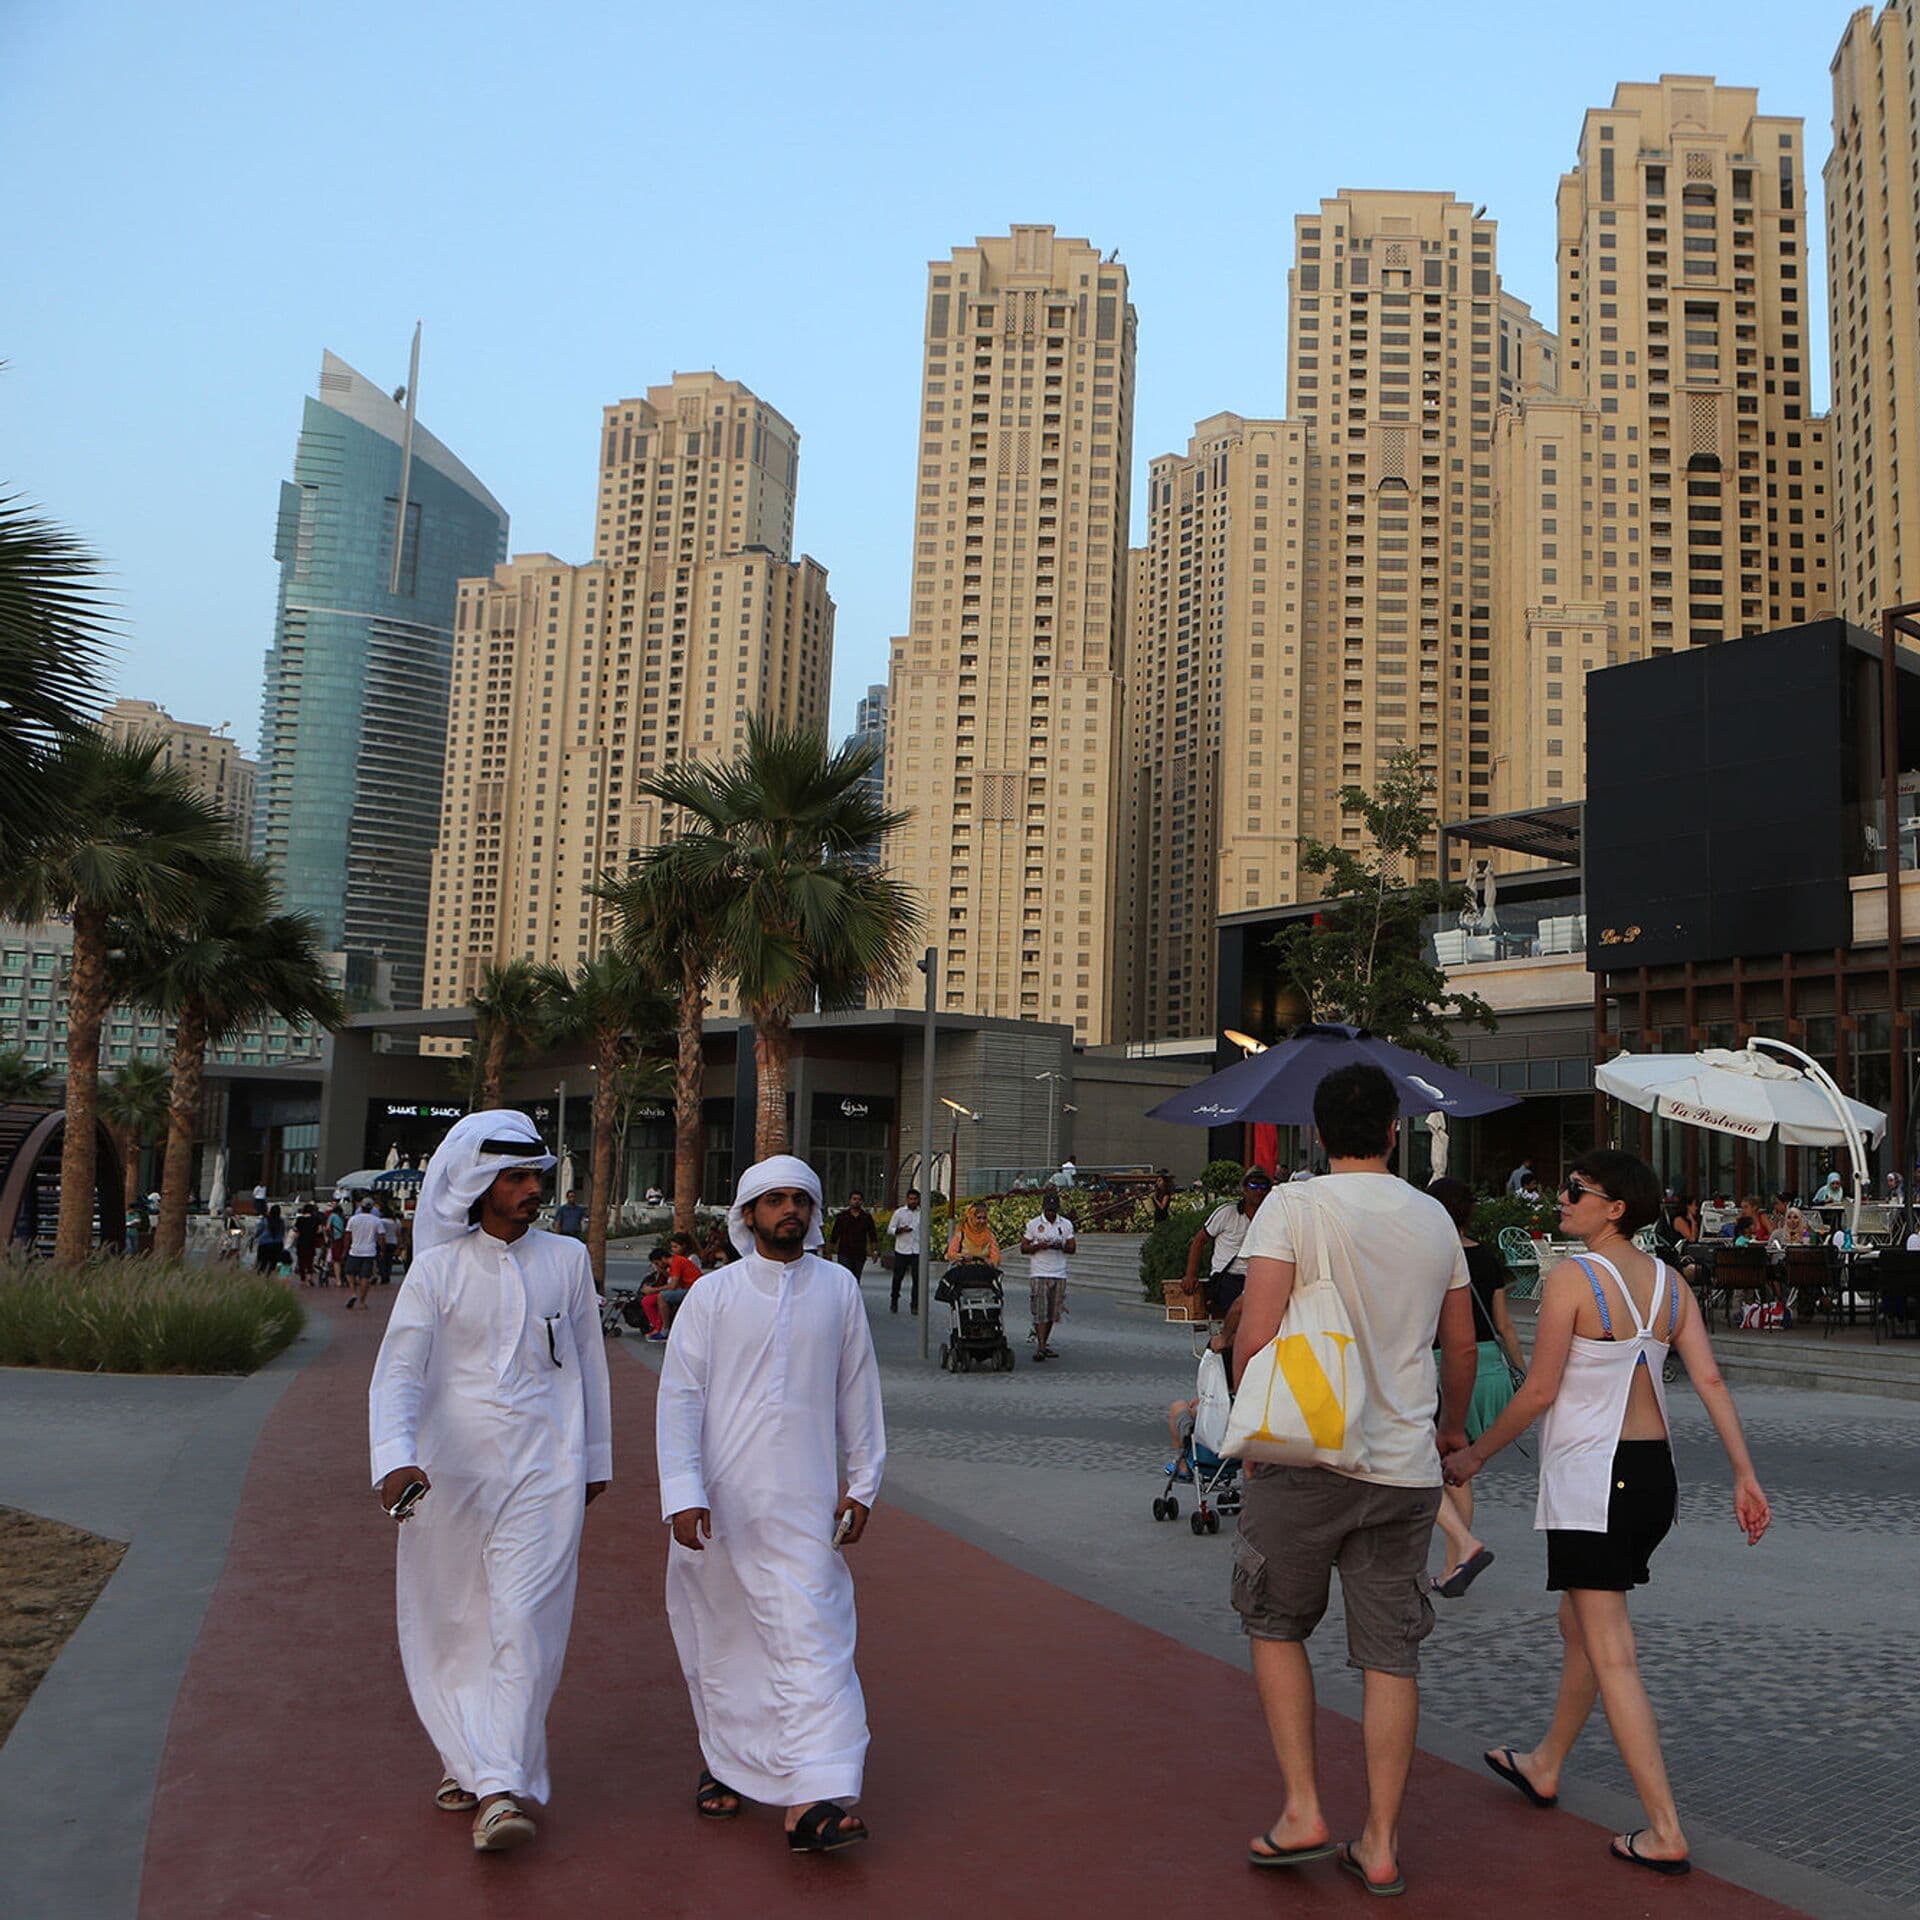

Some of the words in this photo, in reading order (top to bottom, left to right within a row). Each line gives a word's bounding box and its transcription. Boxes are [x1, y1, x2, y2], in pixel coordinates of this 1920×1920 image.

[387, 1105, 418, 1116] SHAKE
[431, 1106, 461, 1117] SHACK
[1670, 1101, 1688, 1117] La
[1243, 1331, 1357, 1451] N
